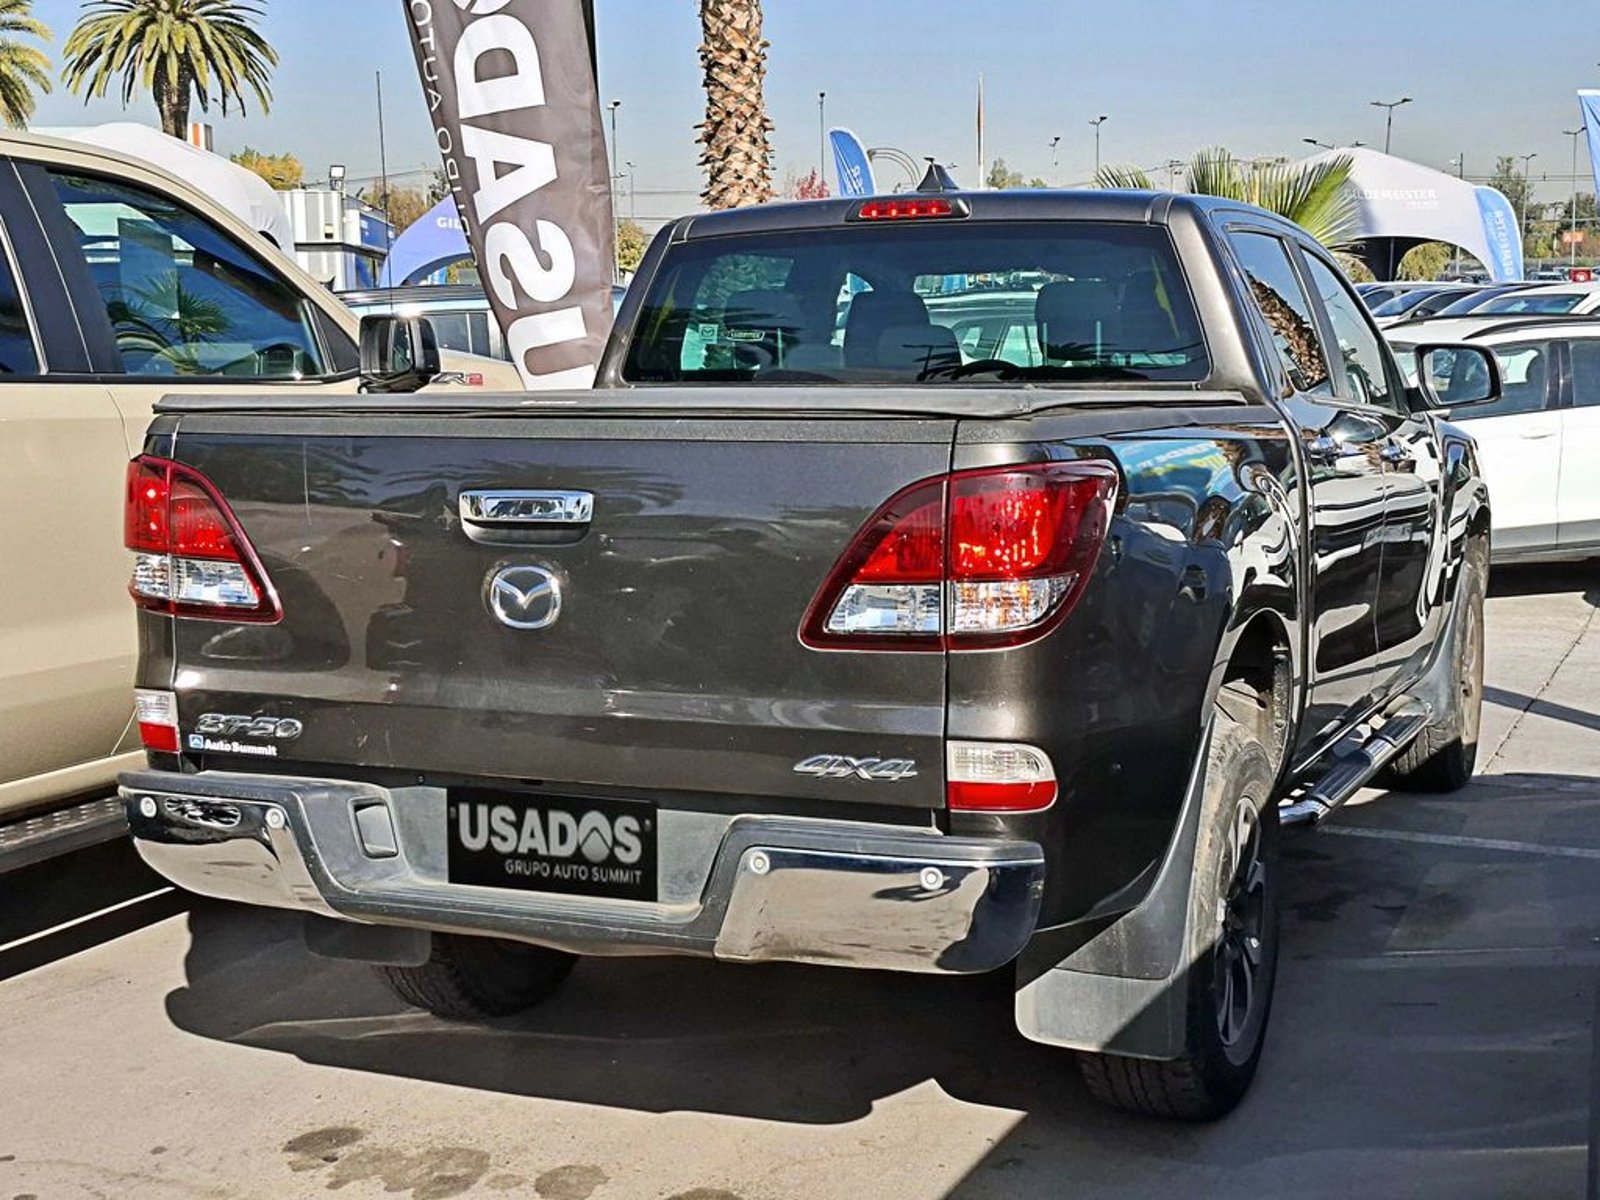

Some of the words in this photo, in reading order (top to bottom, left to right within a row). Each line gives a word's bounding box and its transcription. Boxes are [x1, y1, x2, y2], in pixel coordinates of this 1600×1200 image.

[204, 739, 232, 752] Auto
[232, 742, 278, 756] Summit
[458, 803, 642, 864] USADOS
[505, 859, 550, 877] GRUPO
[553, 864, 589, 881] AUTO
[591, 869, 643, 885] SUMMIT
